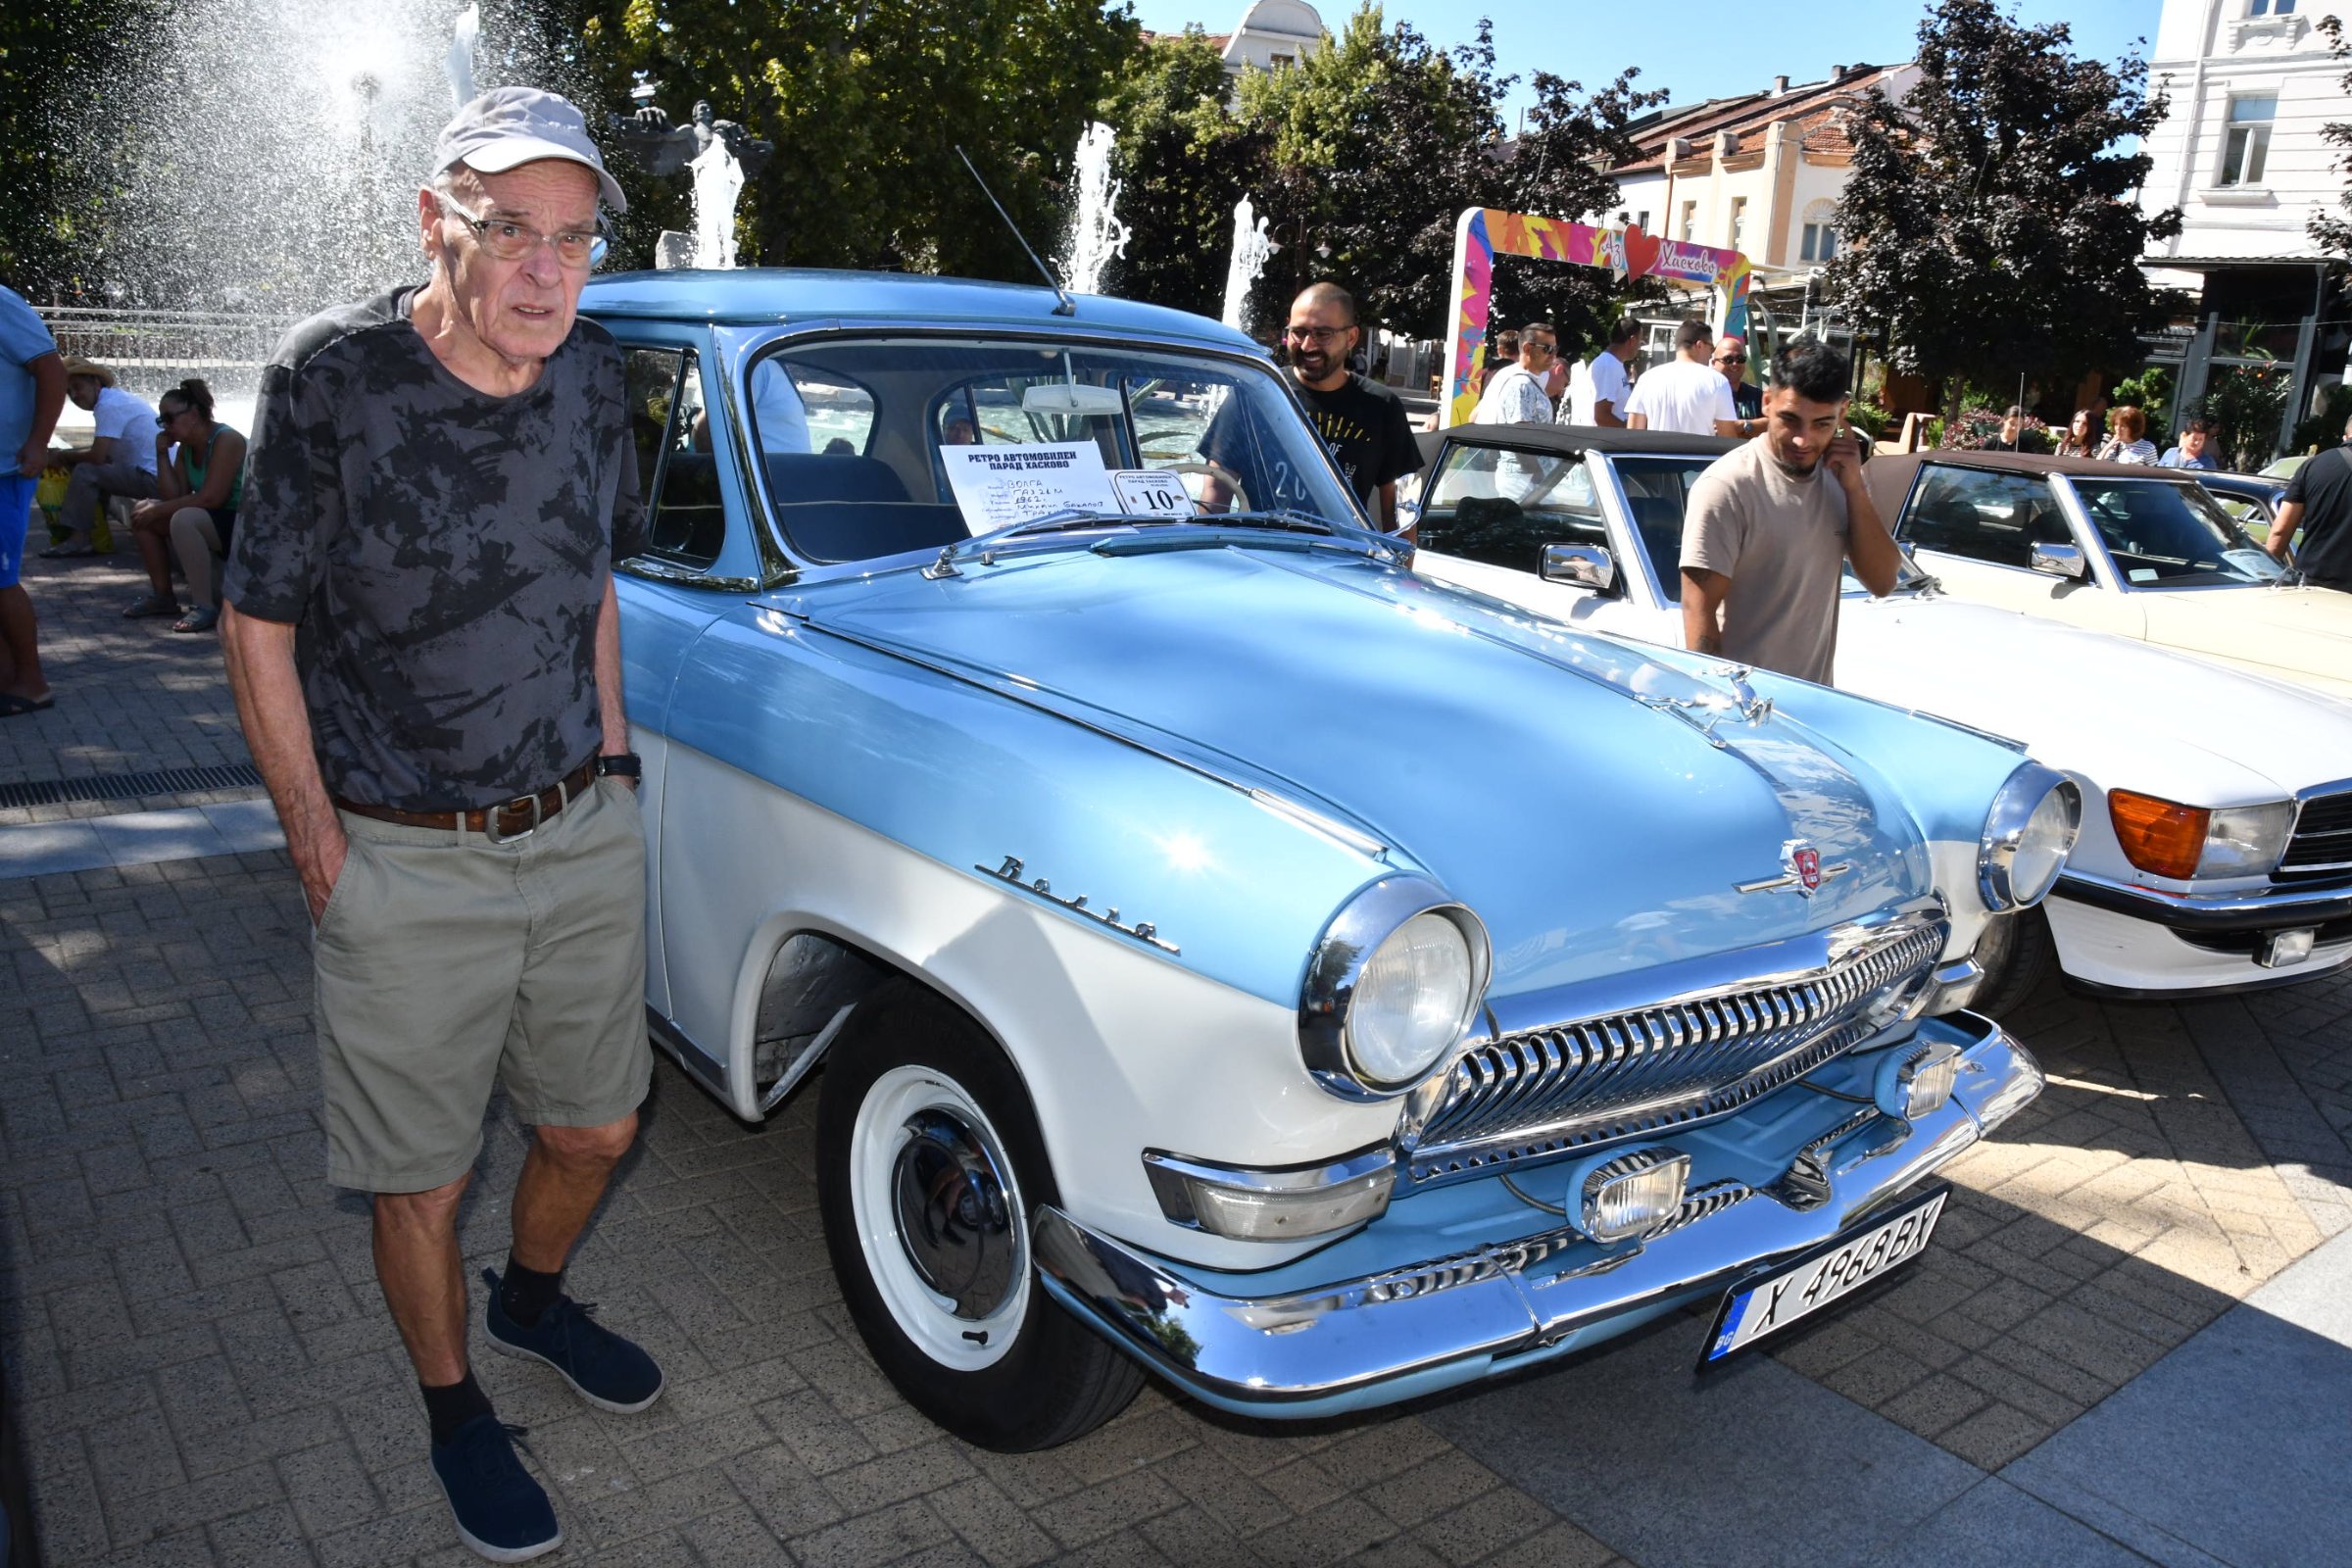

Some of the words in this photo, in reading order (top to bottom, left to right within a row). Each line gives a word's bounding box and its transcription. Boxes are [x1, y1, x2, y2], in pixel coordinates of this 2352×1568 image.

[1662, 242, 1715, 273] Хасково
[968, 454, 1001, 463] РЕТРО
[1004, 451, 1077, 462] АВТОМОБИЛЕН
[989, 462, 1023, 470] ПАРАД
[1025, 460, 1069, 469] ХАСКОВО
[1141, 489, 1174, 511] 10
[1713, 1331, 1735, 1351] BG
